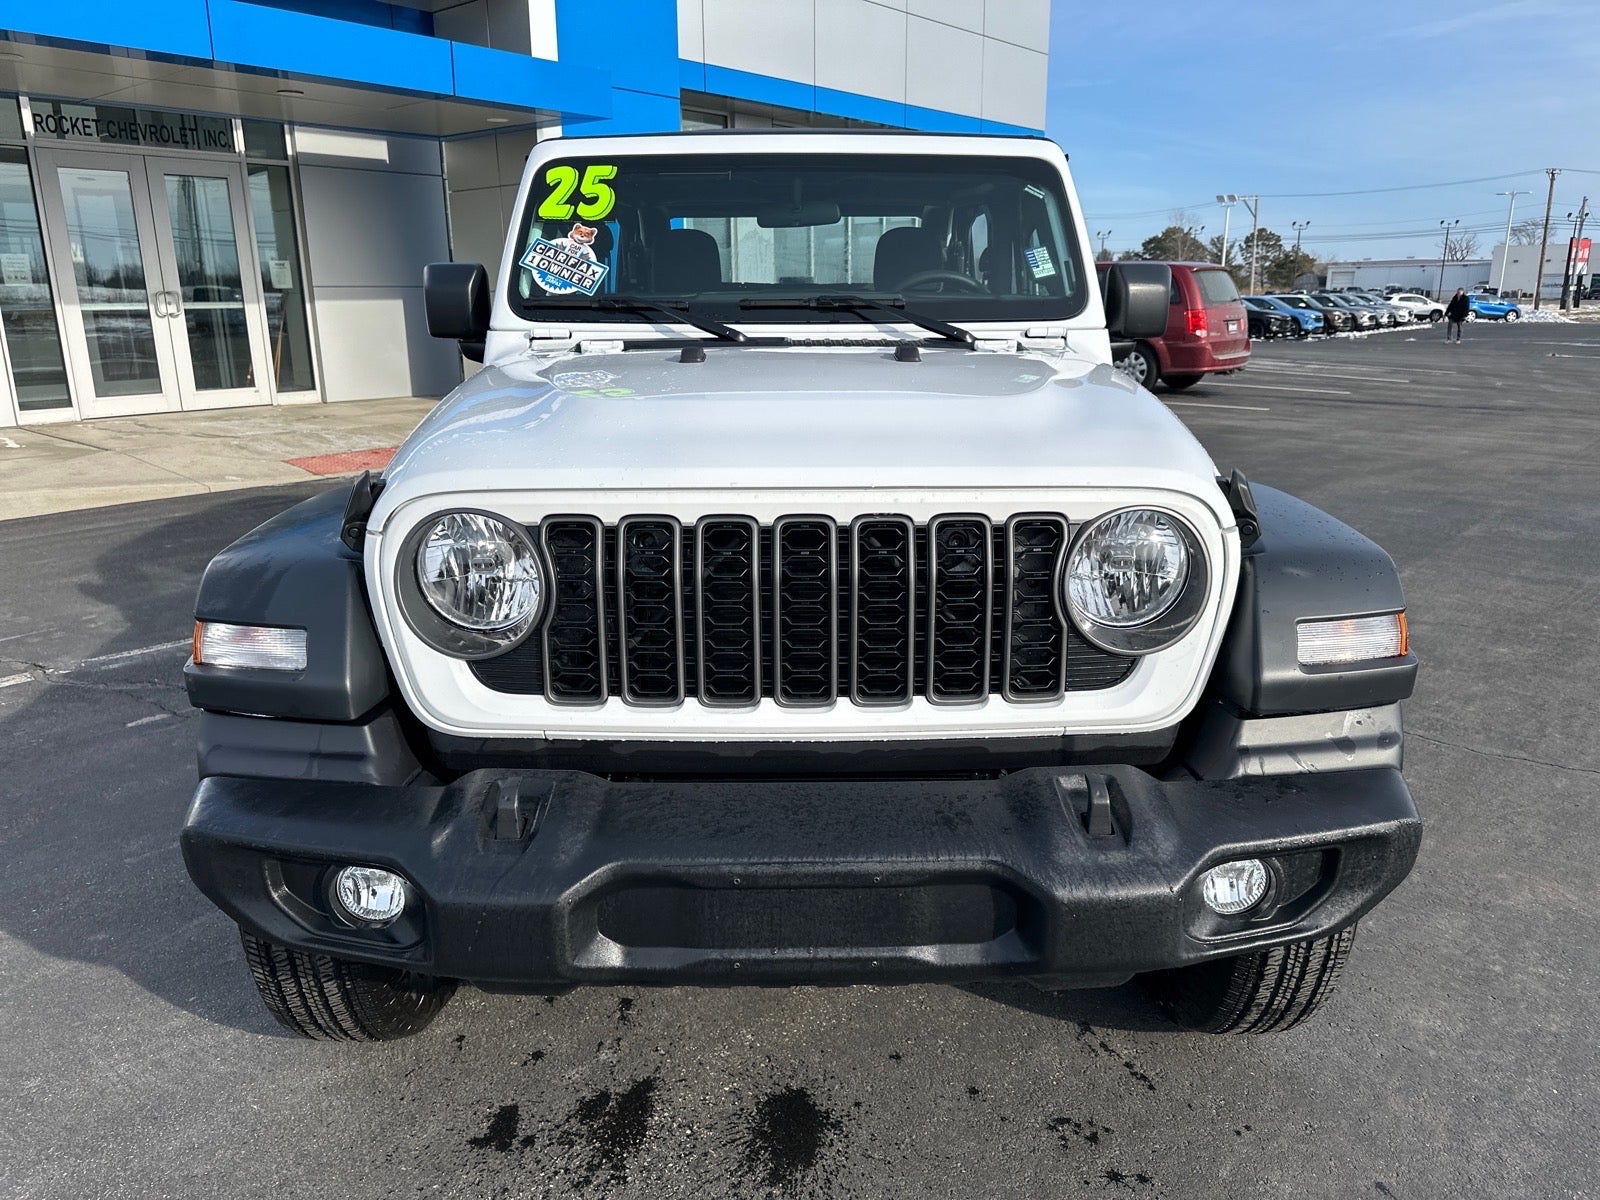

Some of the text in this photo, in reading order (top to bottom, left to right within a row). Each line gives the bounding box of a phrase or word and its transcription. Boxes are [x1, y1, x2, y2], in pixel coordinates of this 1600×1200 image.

[33, 113, 232, 149] ROCKET CHEVROLET INC.
[538, 165, 618, 221] 25
[528, 254, 537, 265] 1
[538, 259, 593, 289] OWNER
[535, 244, 599, 279] CARFAX
